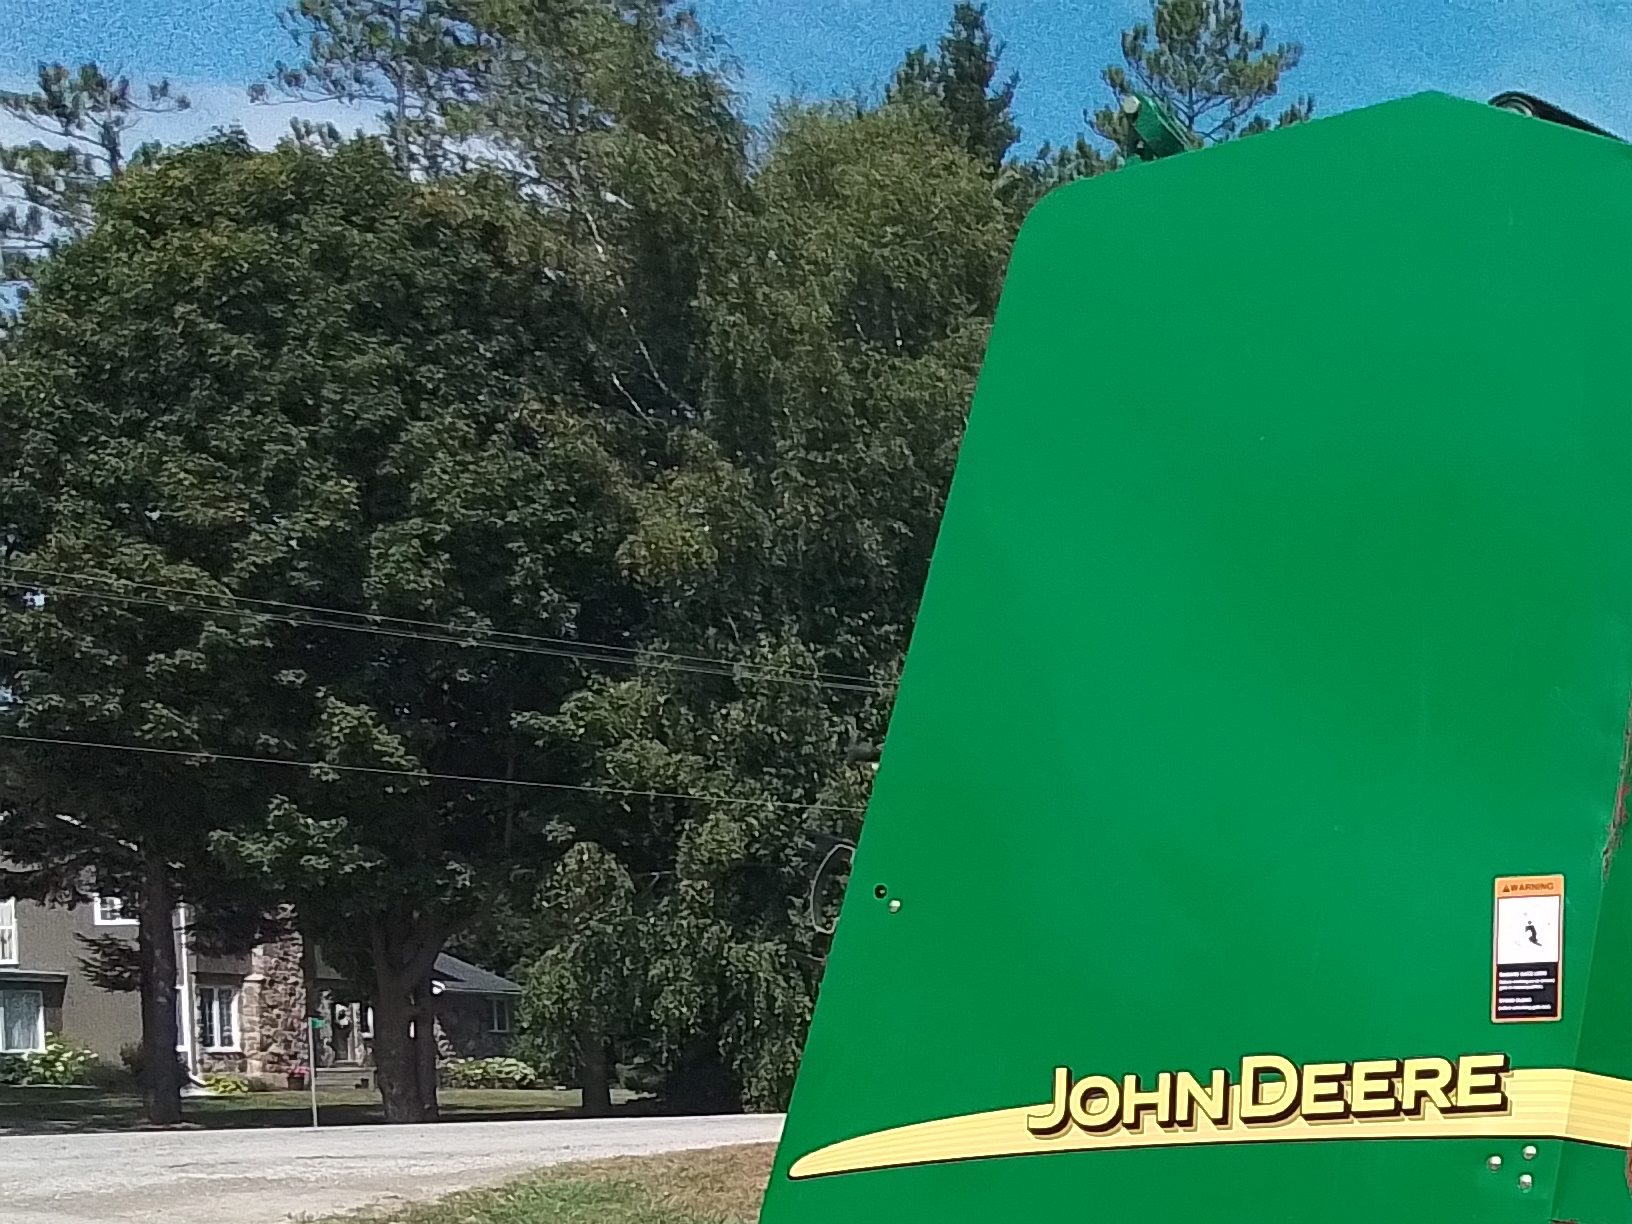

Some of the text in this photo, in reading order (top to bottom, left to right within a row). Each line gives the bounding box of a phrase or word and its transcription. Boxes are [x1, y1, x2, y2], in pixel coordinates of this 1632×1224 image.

[1510, 882, 1554, 892] WARNING
[1027, 1054, 1509, 1136] JOHN DEERE
